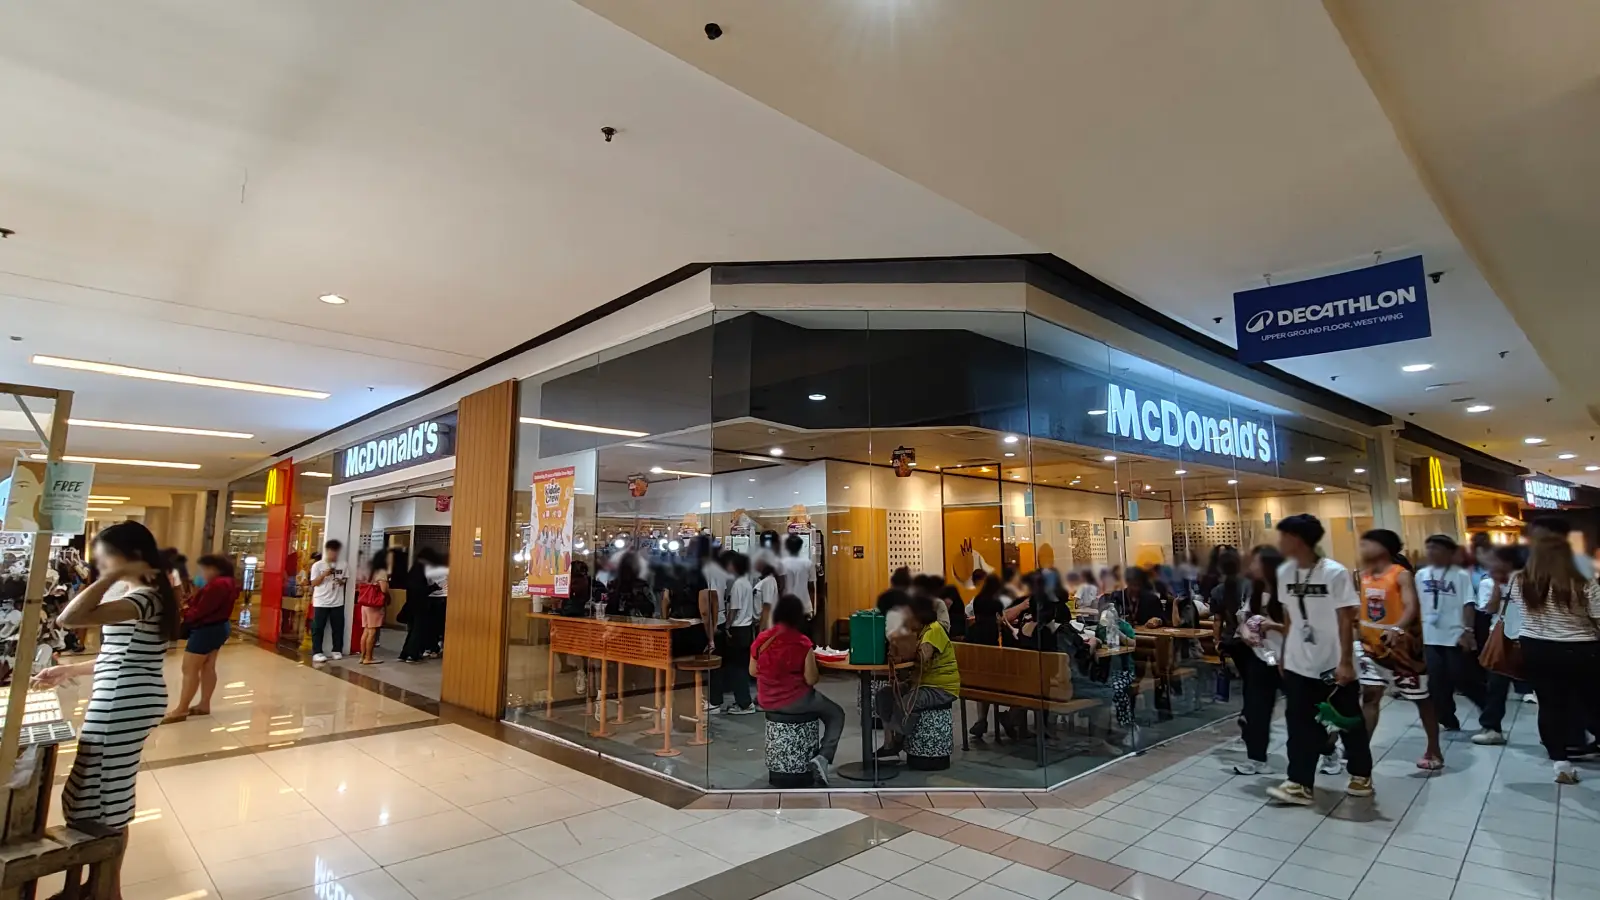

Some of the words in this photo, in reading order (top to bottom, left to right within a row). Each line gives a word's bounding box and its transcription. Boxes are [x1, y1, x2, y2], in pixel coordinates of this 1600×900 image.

[1277, 286, 1417, 326] DECATHLON
[1261, 332, 1287, 342] UPPER
[1287, 327, 1322, 338] GROUND
[1322, 322, 1353, 333] FLOOR,
[1353, 318, 1377, 328] WEST
[1377, 312, 1404, 324] WING
[1107, 383, 1271, 463] McDonald's
[345, 421, 438, 478] McDonald's
[53, 480, 84, 492] FREE
